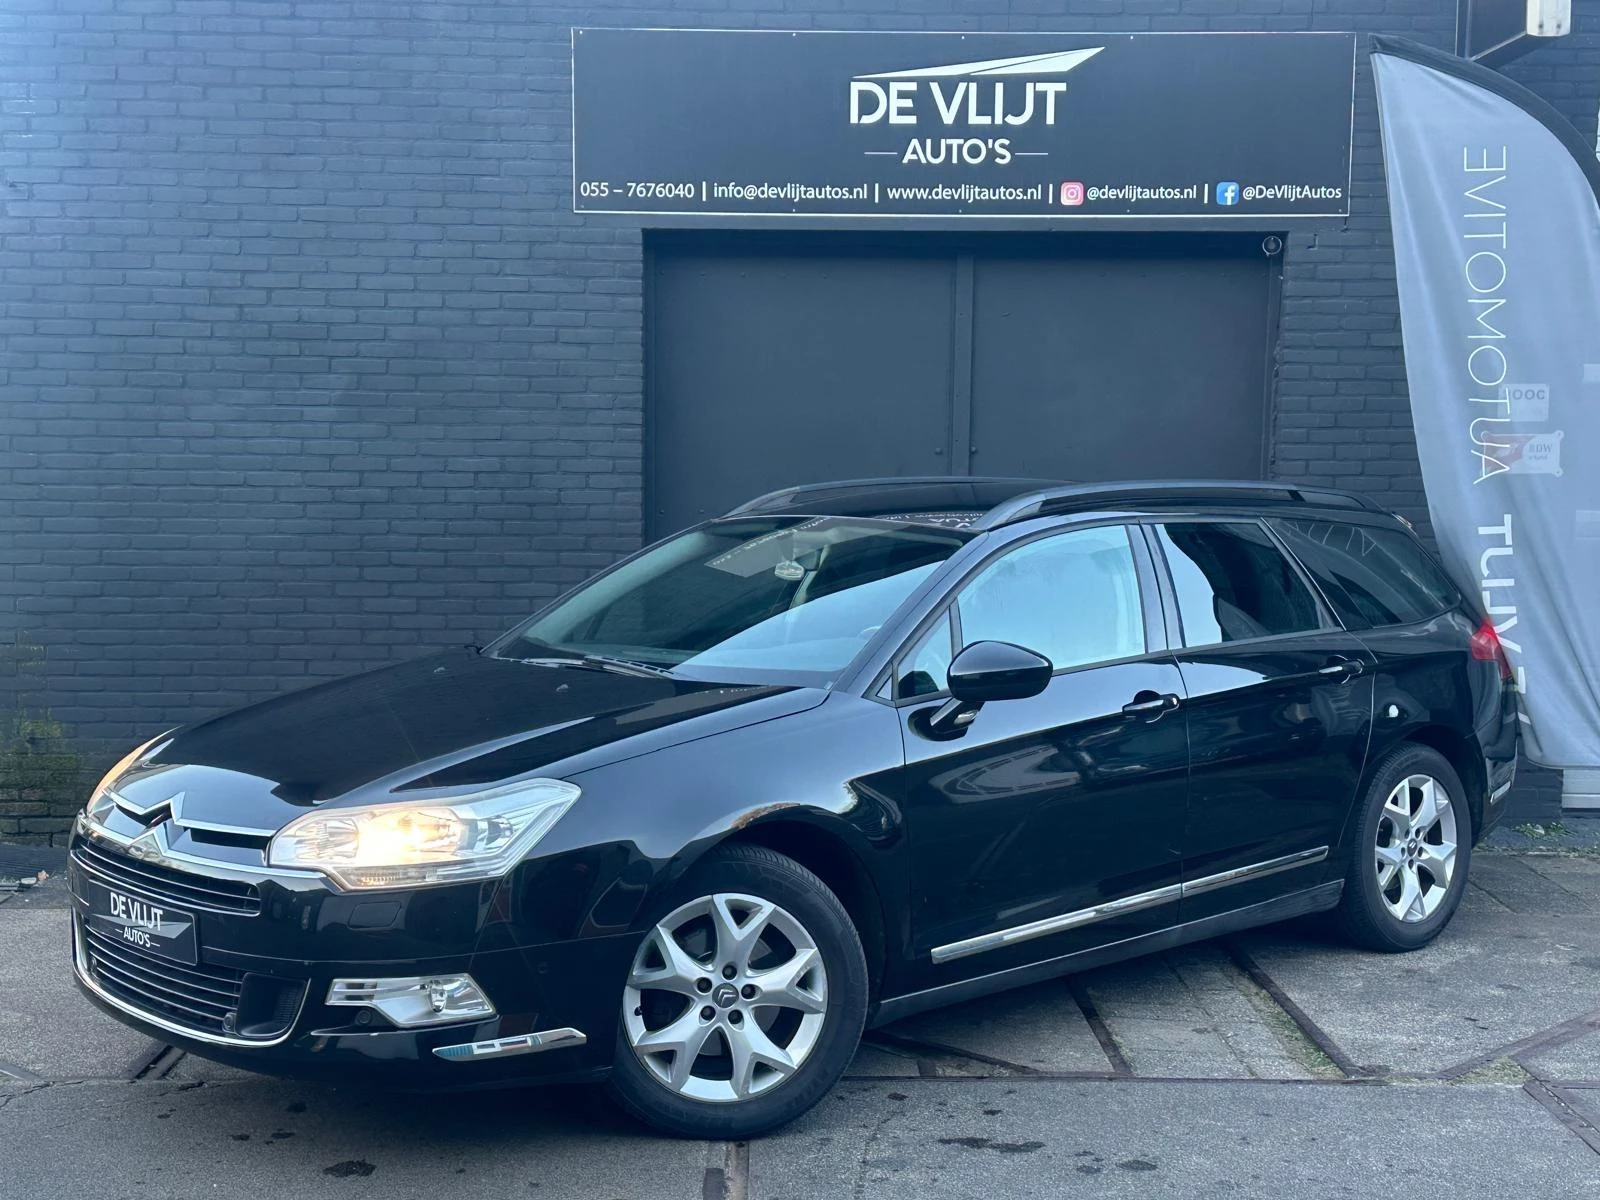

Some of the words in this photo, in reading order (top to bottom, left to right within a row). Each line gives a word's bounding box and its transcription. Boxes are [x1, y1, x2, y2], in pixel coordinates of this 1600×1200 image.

[850, 81, 918, 125] DE
[929, 82, 1067, 126] VLIJT
[902, 138, 1012, 165] AUTO'S
[580, 182, 609, 197] 055
[627, 182, 695, 199] 7676040
[713, 182, 868, 203] info@devlijtautos.nl
[887, 184, 1042, 204] www.devlijtautos.nl
[1086, 184, 1197, 203] @devlijtautos.nl
[1242, 184, 1342, 202] @DeVlijtAutos
[110, 891, 127, 919] DE
[127, 898, 164, 932] VLIJT
[123, 926, 151, 948] AUTO'S
